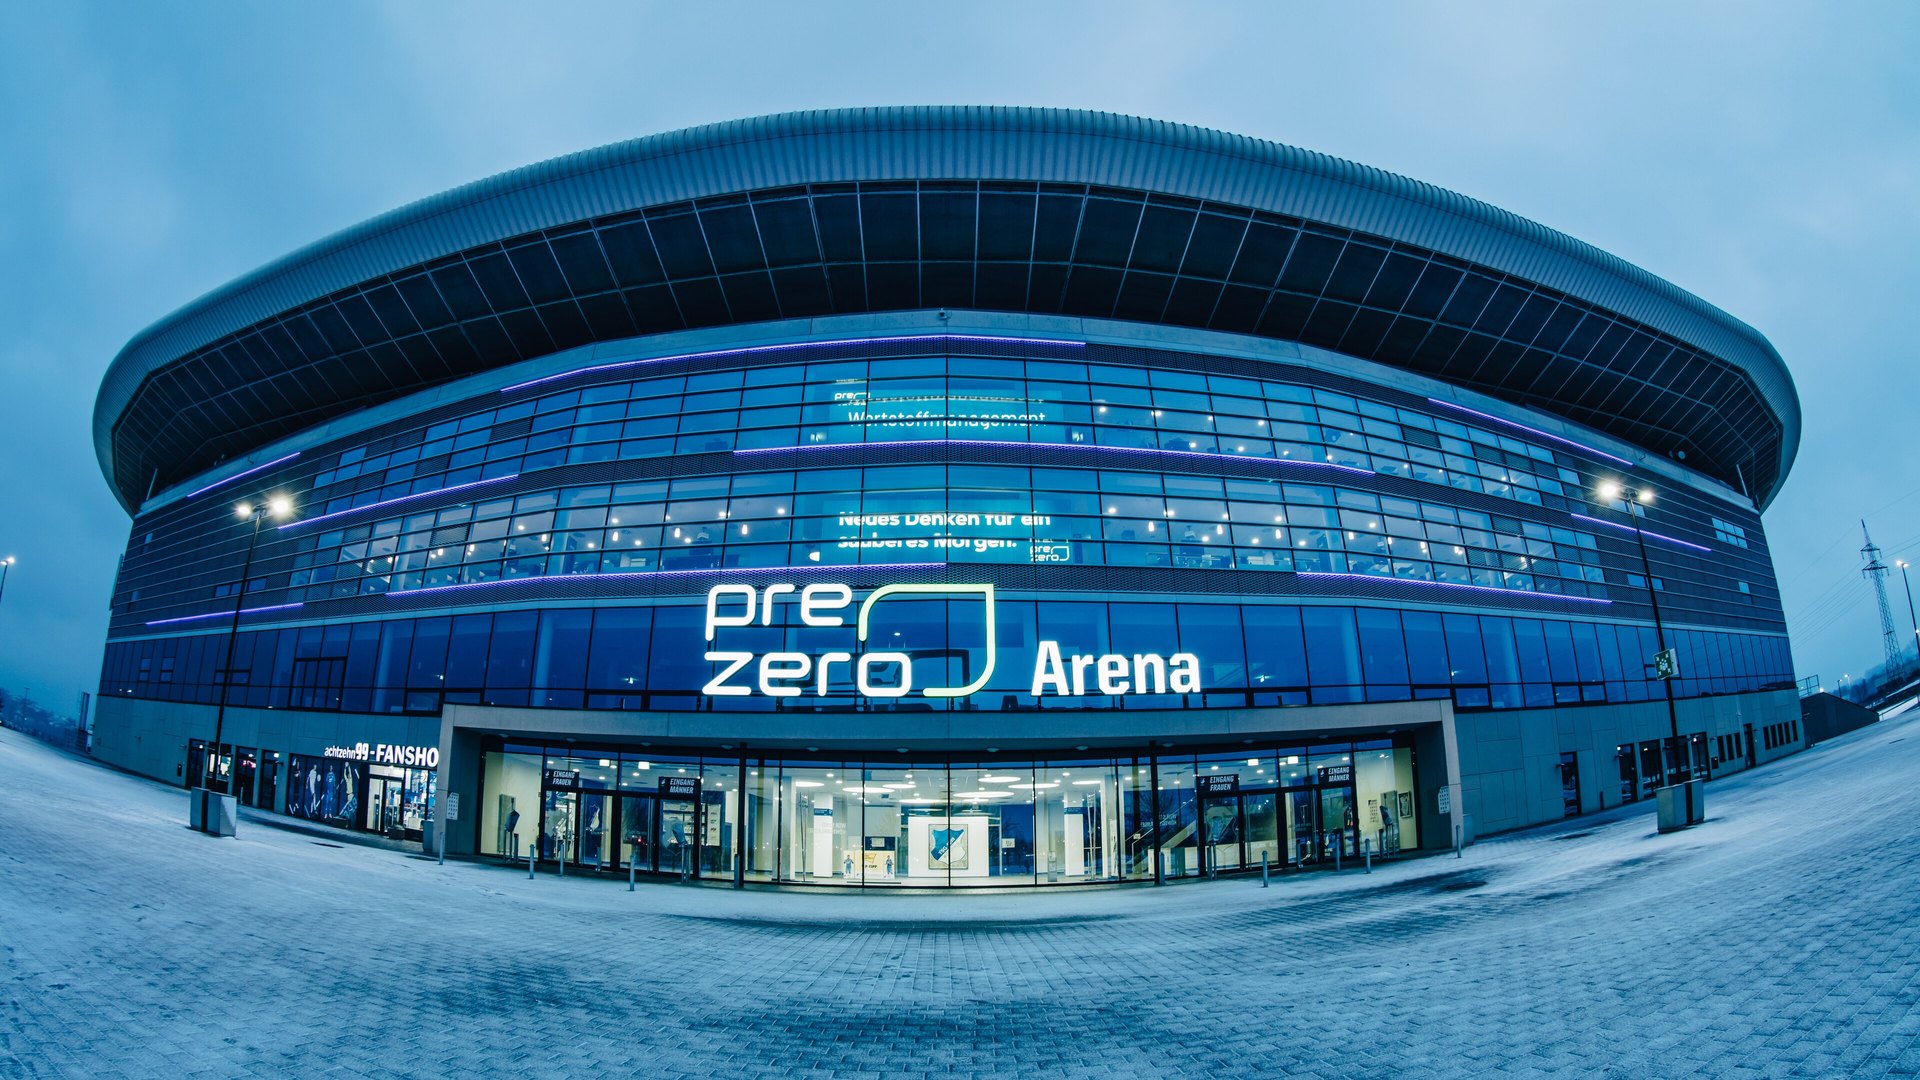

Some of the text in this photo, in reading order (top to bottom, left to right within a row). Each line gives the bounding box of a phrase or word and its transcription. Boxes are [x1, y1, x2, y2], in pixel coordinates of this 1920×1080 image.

[839, 512, 900, 526] Neues
[905, 512, 980, 526] Denken
[1021, 511, 1051, 526] ein
[837, 532, 929, 548] sauberes
[933, 532, 1017, 552] Morgen.
[1029, 545, 1051, 554] pre
[1030, 554, 1059, 562] zero
[705, 583, 854, 641] pre
[1031, 640, 1202, 697] Arena
[702, 651, 913, 698] zero
[553, 770, 576, 779] EINGANG
[1328, 766, 1350, 775] EINGANG
[552, 778, 572, 786] FRAUEN
[670, 778, 695, 786] EINGANG
[1209, 775, 1234, 783] EINGANG
[1209, 783, 1232, 791] FRAUEN
